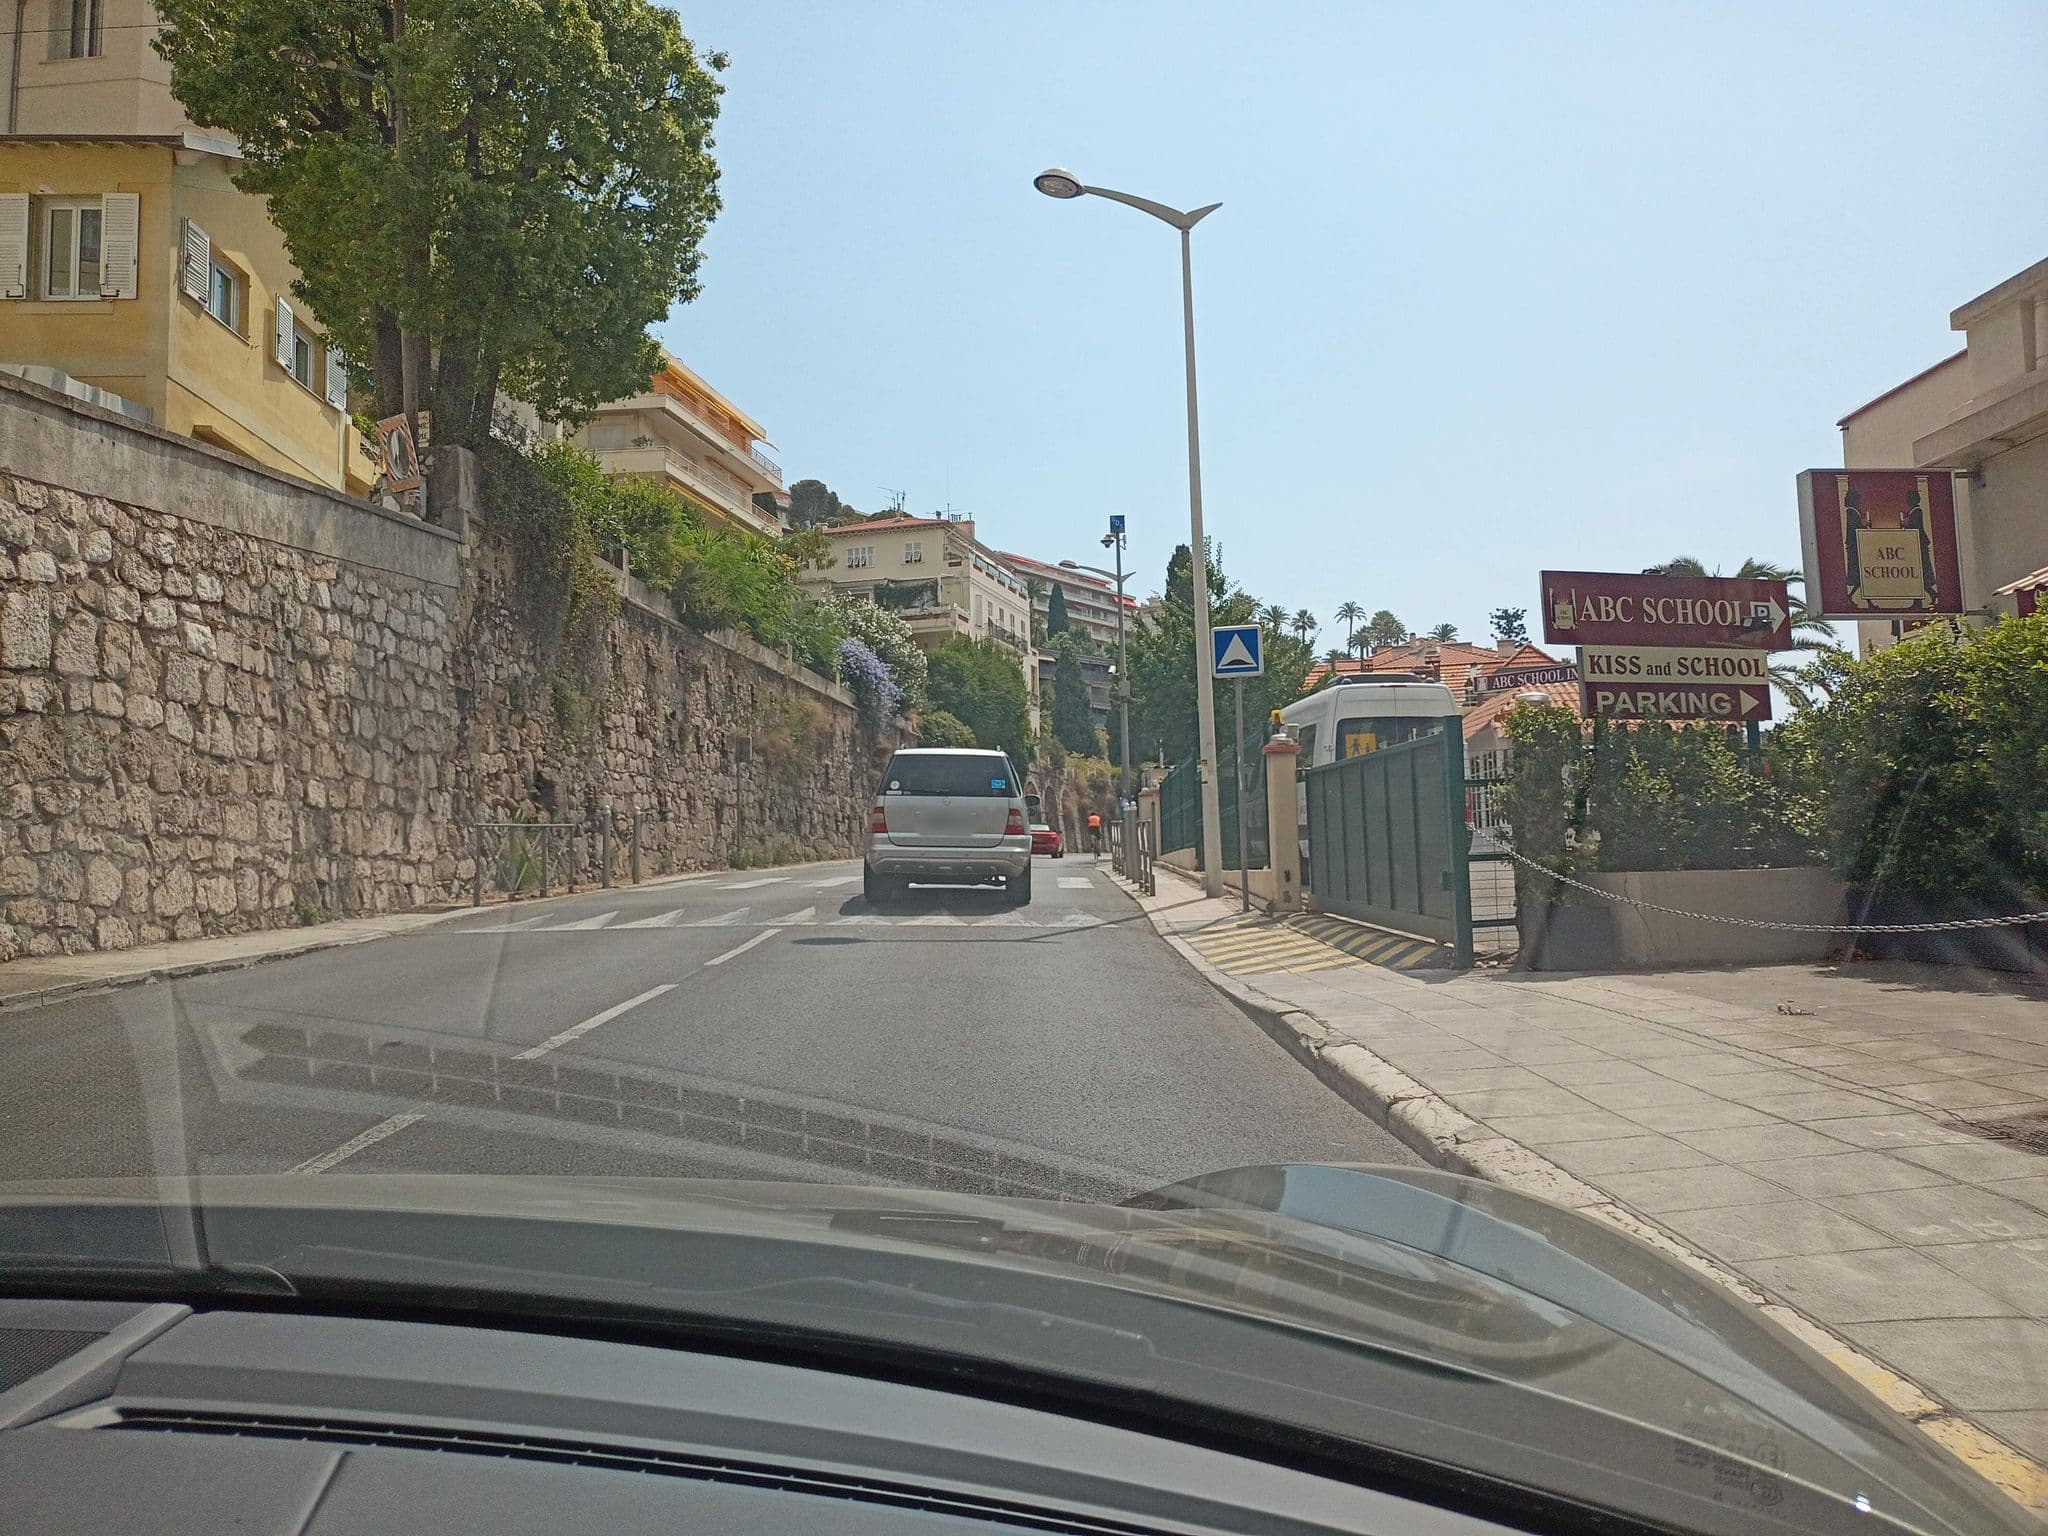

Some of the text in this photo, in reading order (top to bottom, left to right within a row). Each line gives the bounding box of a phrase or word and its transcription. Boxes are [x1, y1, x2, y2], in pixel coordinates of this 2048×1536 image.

[1876, 547, 1905, 560] ABC
[1863, 566, 1920, 579] SCHOOL
[1580, 595, 1634, 623] ABC
[1642, 597, 1742, 626] SCHOOL
[1588, 654, 1766, 678] KISS and SCHOOL
[1493, 674, 1515, 688] ABC
[1517, 669, 1564, 686] SCHOOL
[1596, 690, 1733, 716] PARKING
